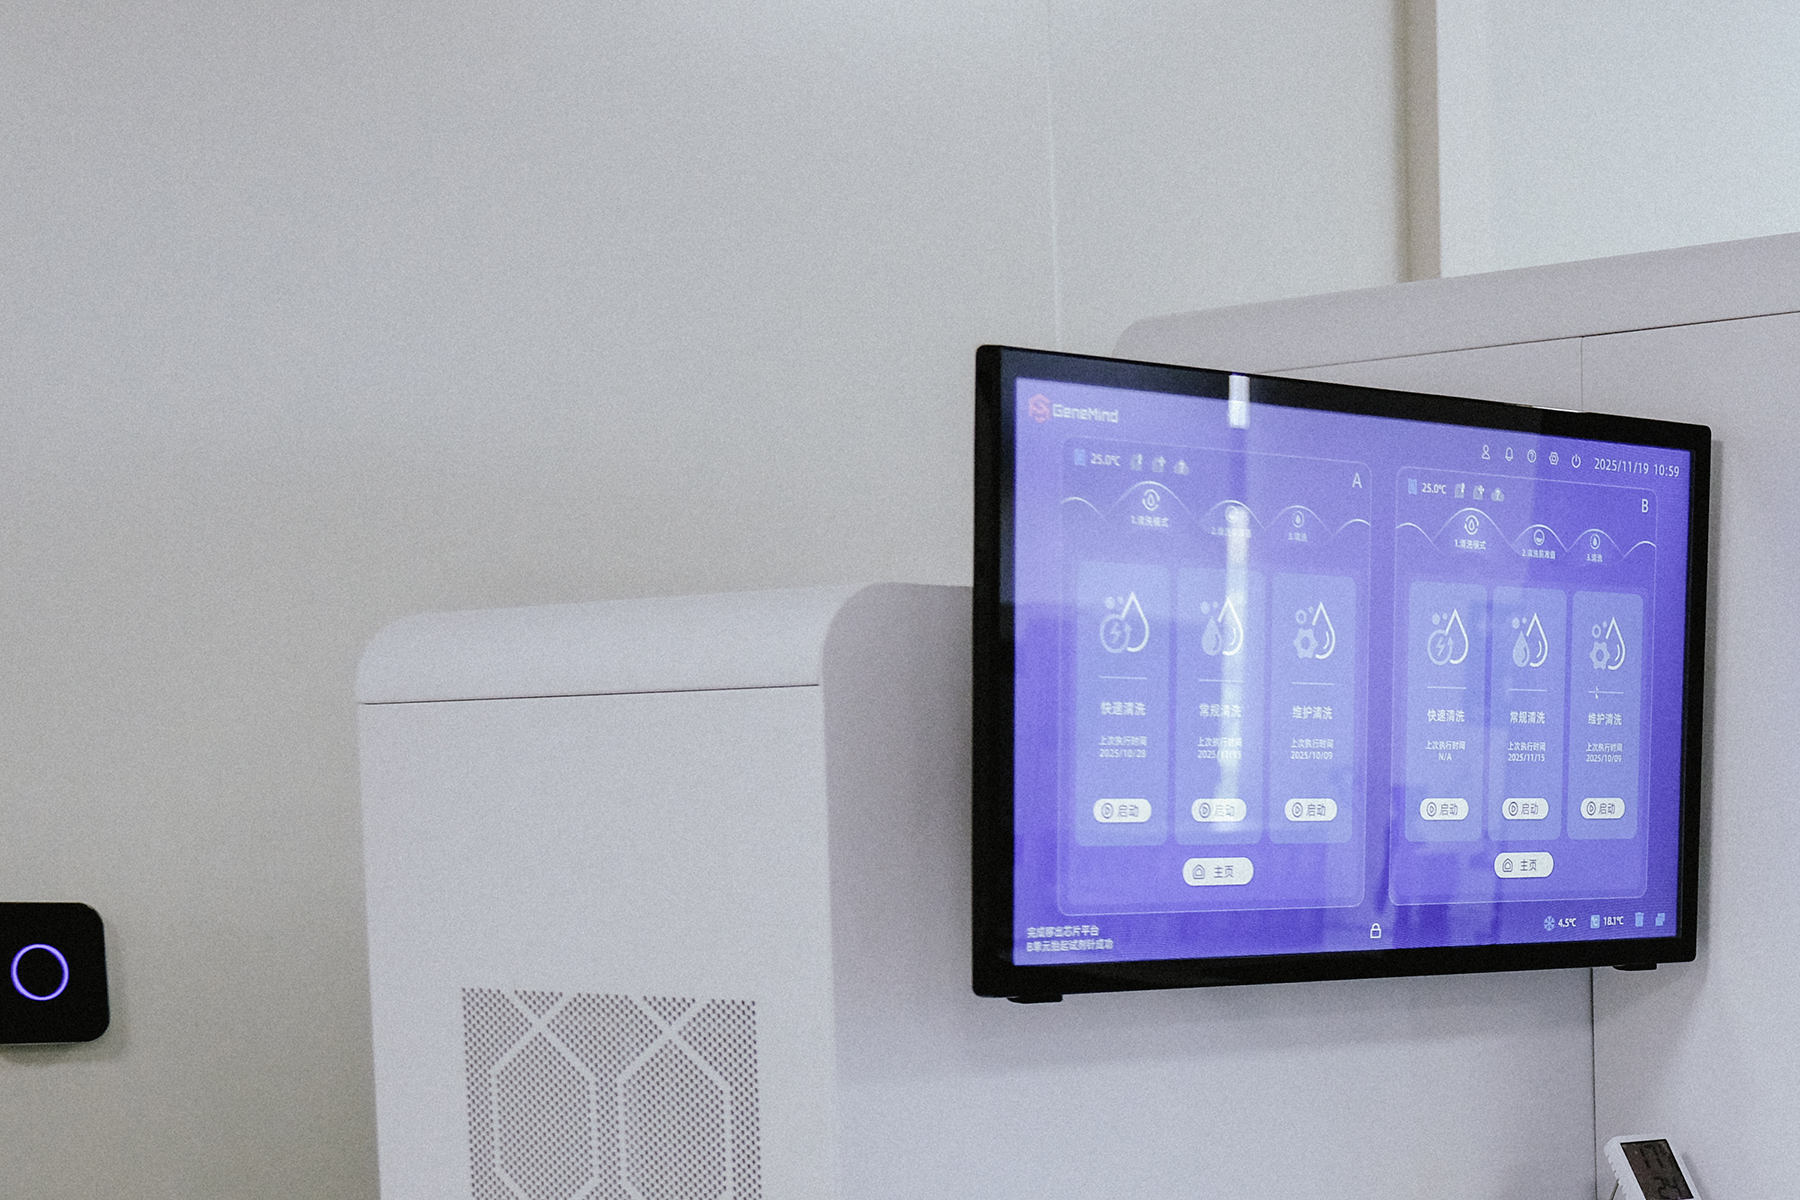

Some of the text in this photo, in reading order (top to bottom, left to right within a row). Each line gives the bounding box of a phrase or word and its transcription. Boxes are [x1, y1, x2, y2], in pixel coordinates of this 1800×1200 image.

[1051, 402, 1119, 424] GeneMind
[1594, 457, 1680, 478] 2025/11/19 10:59
[1351, 471, 1363, 489] A
[1641, 498, 1650, 513] B
[1101, 701, 1146, 716] 快速清洗
[1199, 703, 1242, 718] 常规清洗
[1292, 705, 1333, 720] 维护清洗
[1427, 709, 1466, 723] 快速清洗
[1509, 711, 1546, 725] 常规清洗
[1588, 712, 1622, 726] 维护清洗
[1290, 738, 1334, 749] 上次执行时间
[1425, 740, 1466, 750] 上次执行时间
[1507, 741, 1547, 752] 上次执行时间
[1585, 742, 1623, 752] 上次执行时间
[1290, 750, 1334, 760] 2025/10/09
[1438, 752, 1452, 761] N/A
[1507, 753, 1546, 762] 2025/11/15
[1585, 753, 1622, 763] 2025/10/09
[1117, 803, 1140, 819] 启动
[1213, 802, 1236, 818] 启动
[1306, 802, 1327, 818] 启动
[1439, 802, 1459, 817] 启动
[1520, 802, 1539, 816] 启动
[1598, 802, 1617, 816] 启动
[1213, 865, 1235, 879] 主页
[1519, 858, 1538, 872] 主页
